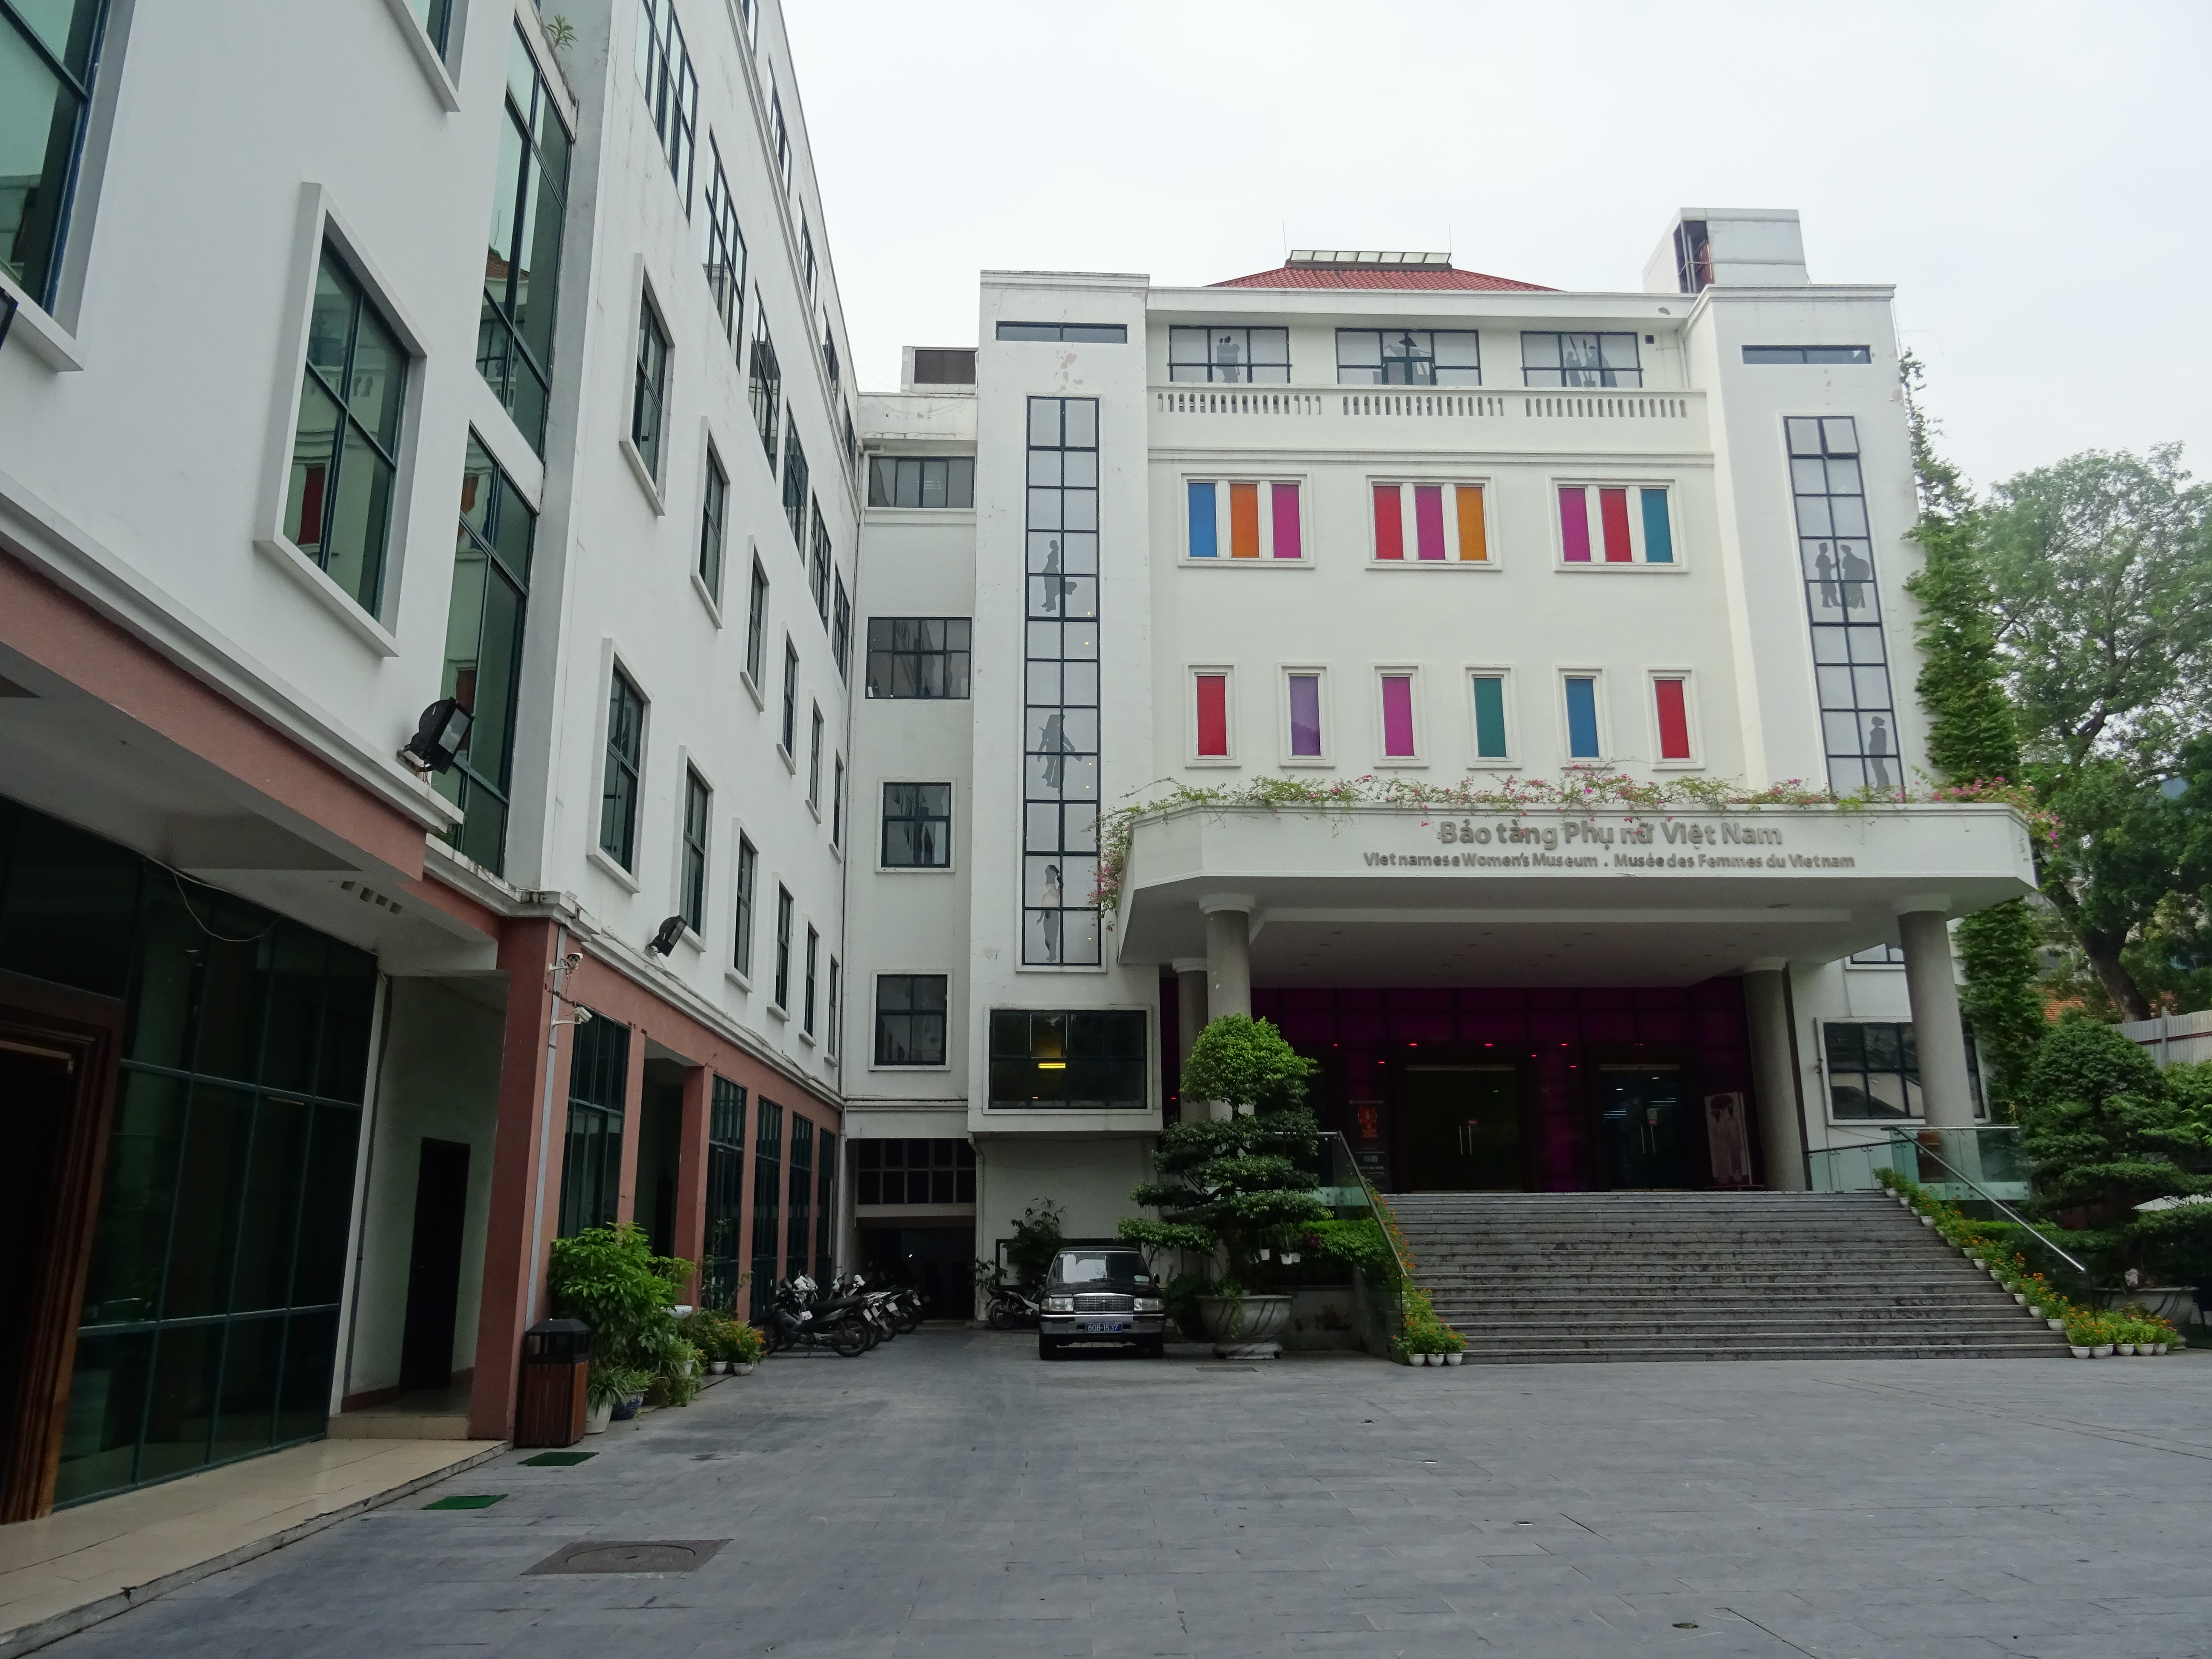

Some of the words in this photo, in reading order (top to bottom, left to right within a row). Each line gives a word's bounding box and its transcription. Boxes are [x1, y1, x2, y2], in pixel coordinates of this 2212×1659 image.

[1441, 818, 1492, 844] Bảo
[1496, 819, 1558, 850] tàng
[1563, 820, 1614, 850] Phụ
[1661, 822, 1716, 849] Việt
[1721, 822, 1782, 844] Nam
[1364, 852, 1460, 866] Vietnamese
[1532, 853, 1598, 867] Museum
[1614, 852, 1664, 867] Musée
[1667, 853, 1694, 867] des
[1698, 853, 1763, 867] Femmes
[1766, 853, 1786, 867] du
[1788, 853, 1855, 867] Vietnam
